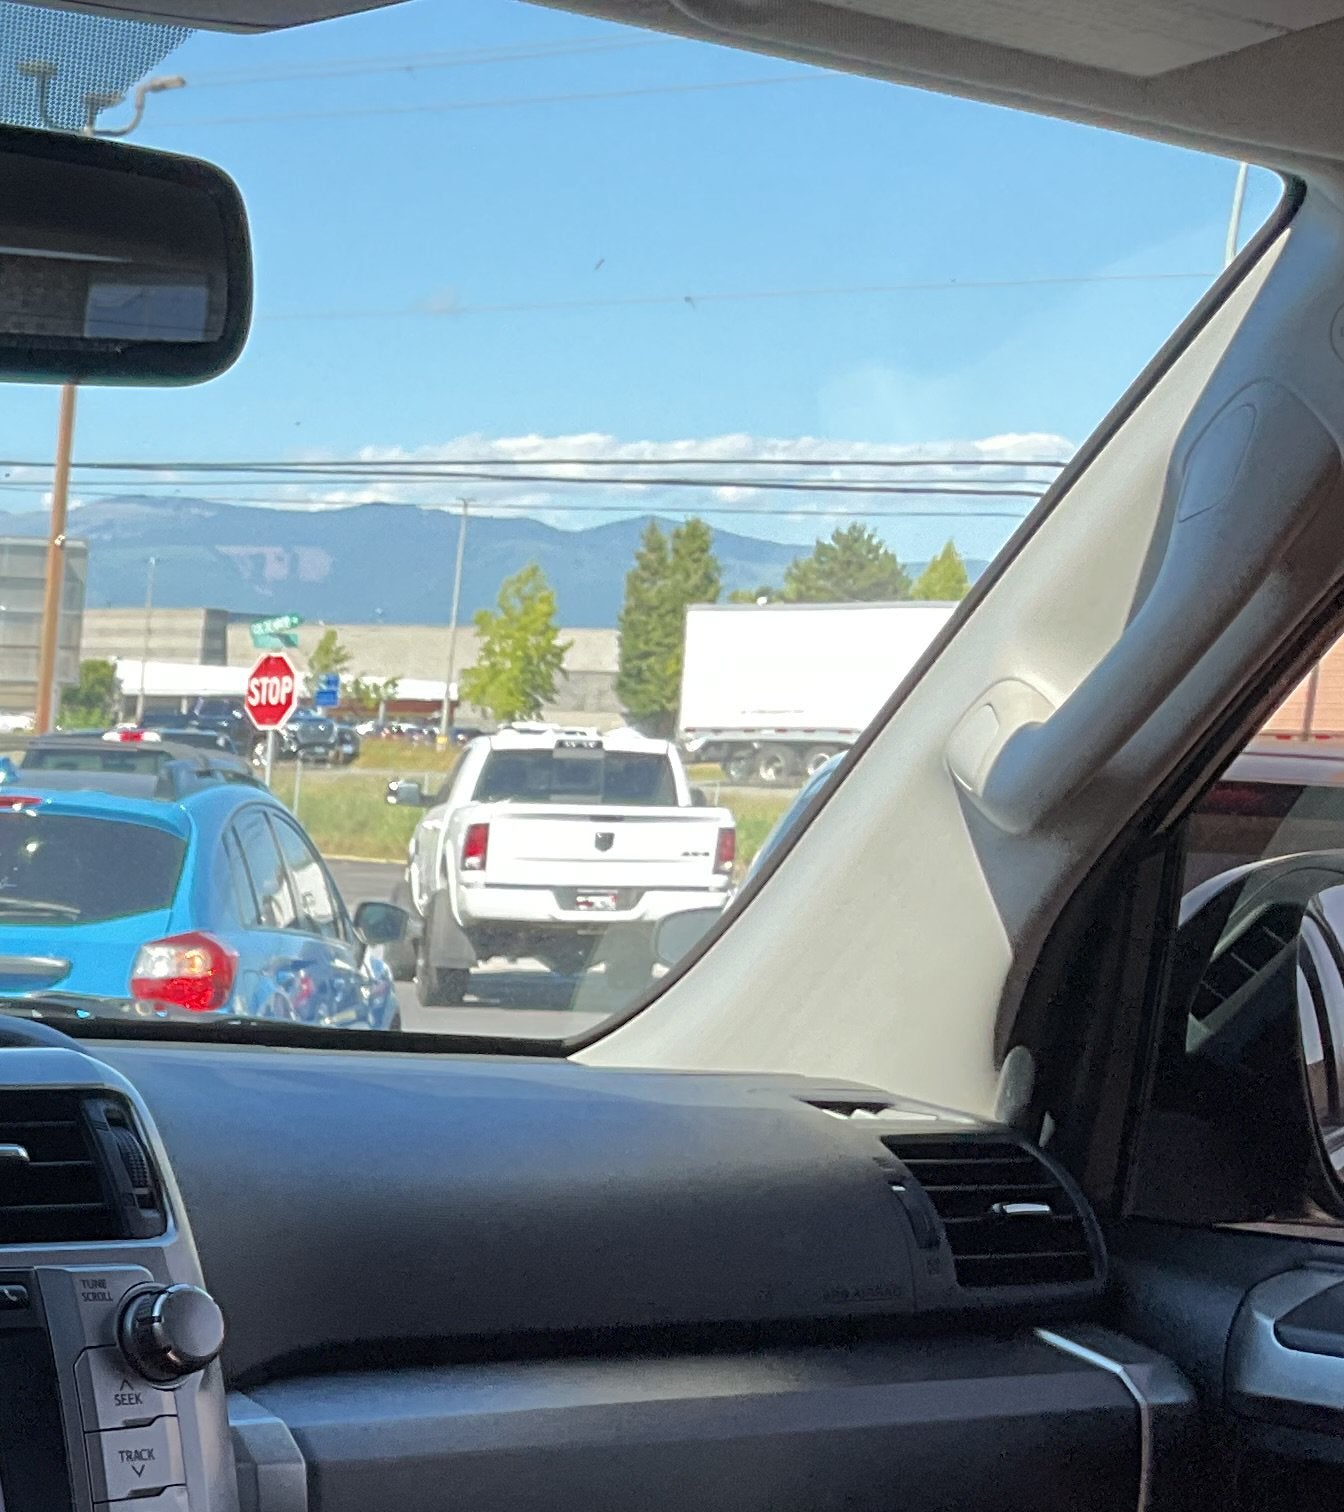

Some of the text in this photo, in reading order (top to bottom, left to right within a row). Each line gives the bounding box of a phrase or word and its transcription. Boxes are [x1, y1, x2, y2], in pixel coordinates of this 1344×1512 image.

[247, 675, 294, 707] STOP
[79, 1279, 107, 1289] TUNE
[81, 1291, 113, 1302] SCROLL
[113, 1392, 143, 1407] SEEK
[118, 1448, 156, 1463] TRACK
